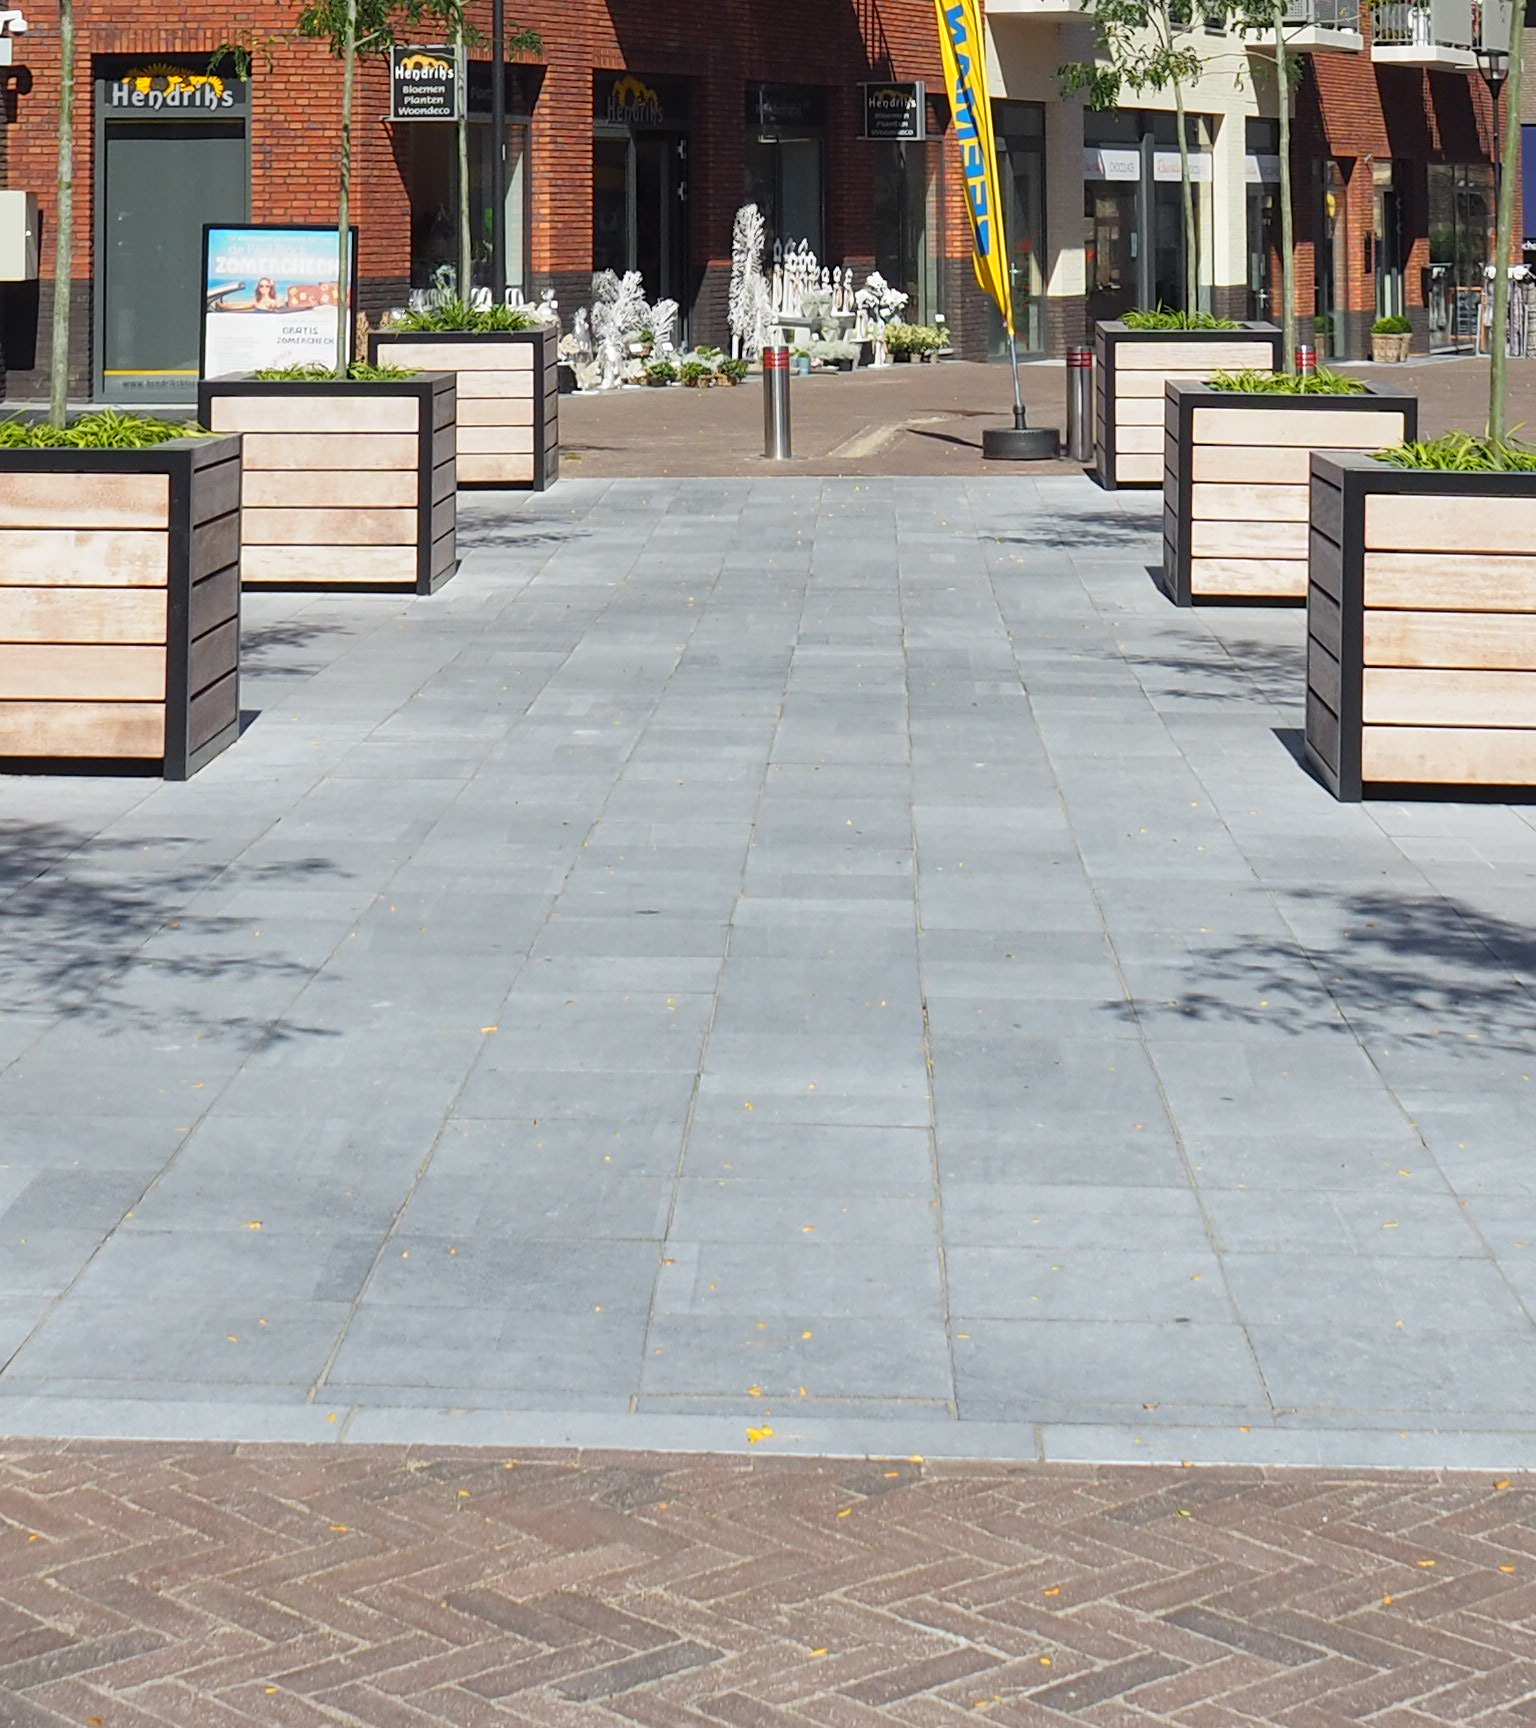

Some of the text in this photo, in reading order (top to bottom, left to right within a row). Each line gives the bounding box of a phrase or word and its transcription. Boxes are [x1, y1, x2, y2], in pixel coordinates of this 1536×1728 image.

[395, 65, 455, 81] Hendriks
[402, 84, 446, 94] Bloemen
[112, 82, 234, 111] Hendriks
[404, 95, 444, 106] Planten
[398, 106, 451, 116] Woondeco
[282, 326, 319, 335] GRATIS
